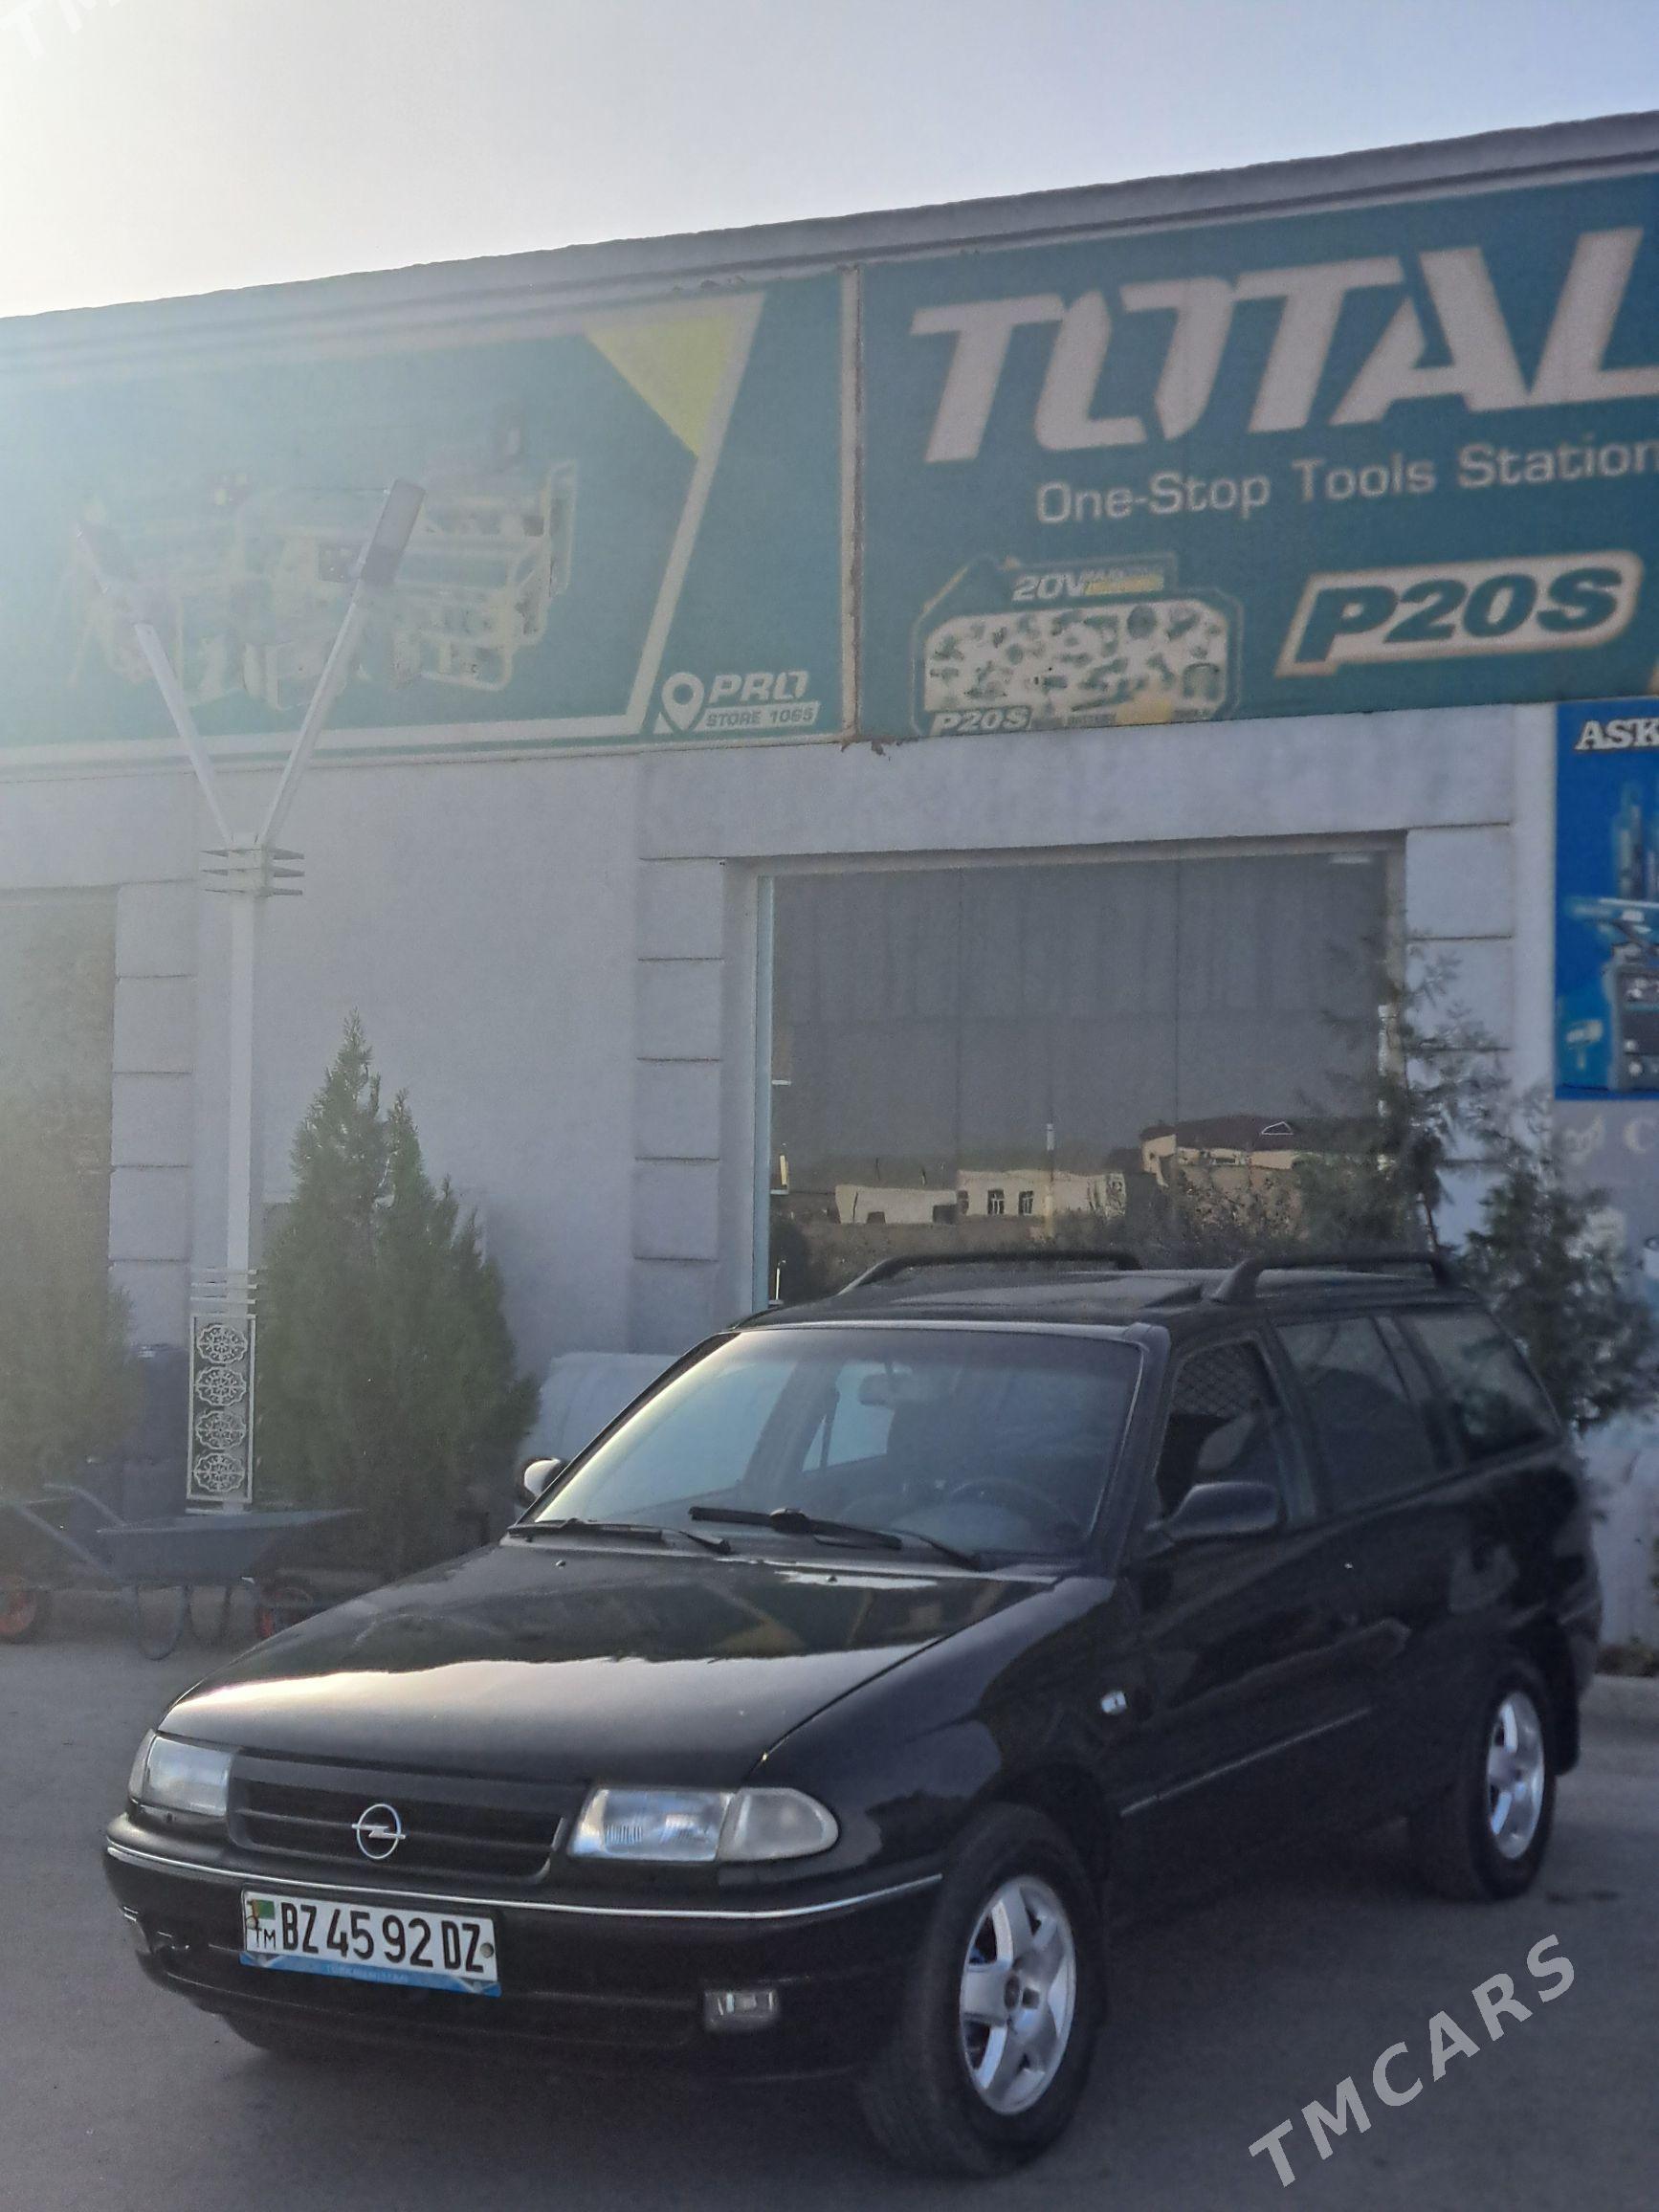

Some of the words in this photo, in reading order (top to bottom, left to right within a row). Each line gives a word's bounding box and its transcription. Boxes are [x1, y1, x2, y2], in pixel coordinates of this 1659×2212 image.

[910, 227, 1659, 464] TOTAL
[1036, 470, 1272, 524] One-Stop
[1292, 452, 1436, 502] Tools
[1458, 433, 1659, 490] Station
[1294, 568, 1624, 664] P20S
[706, 711, 762, 727] STORE
[932, 706, 1030, 736] P20S
